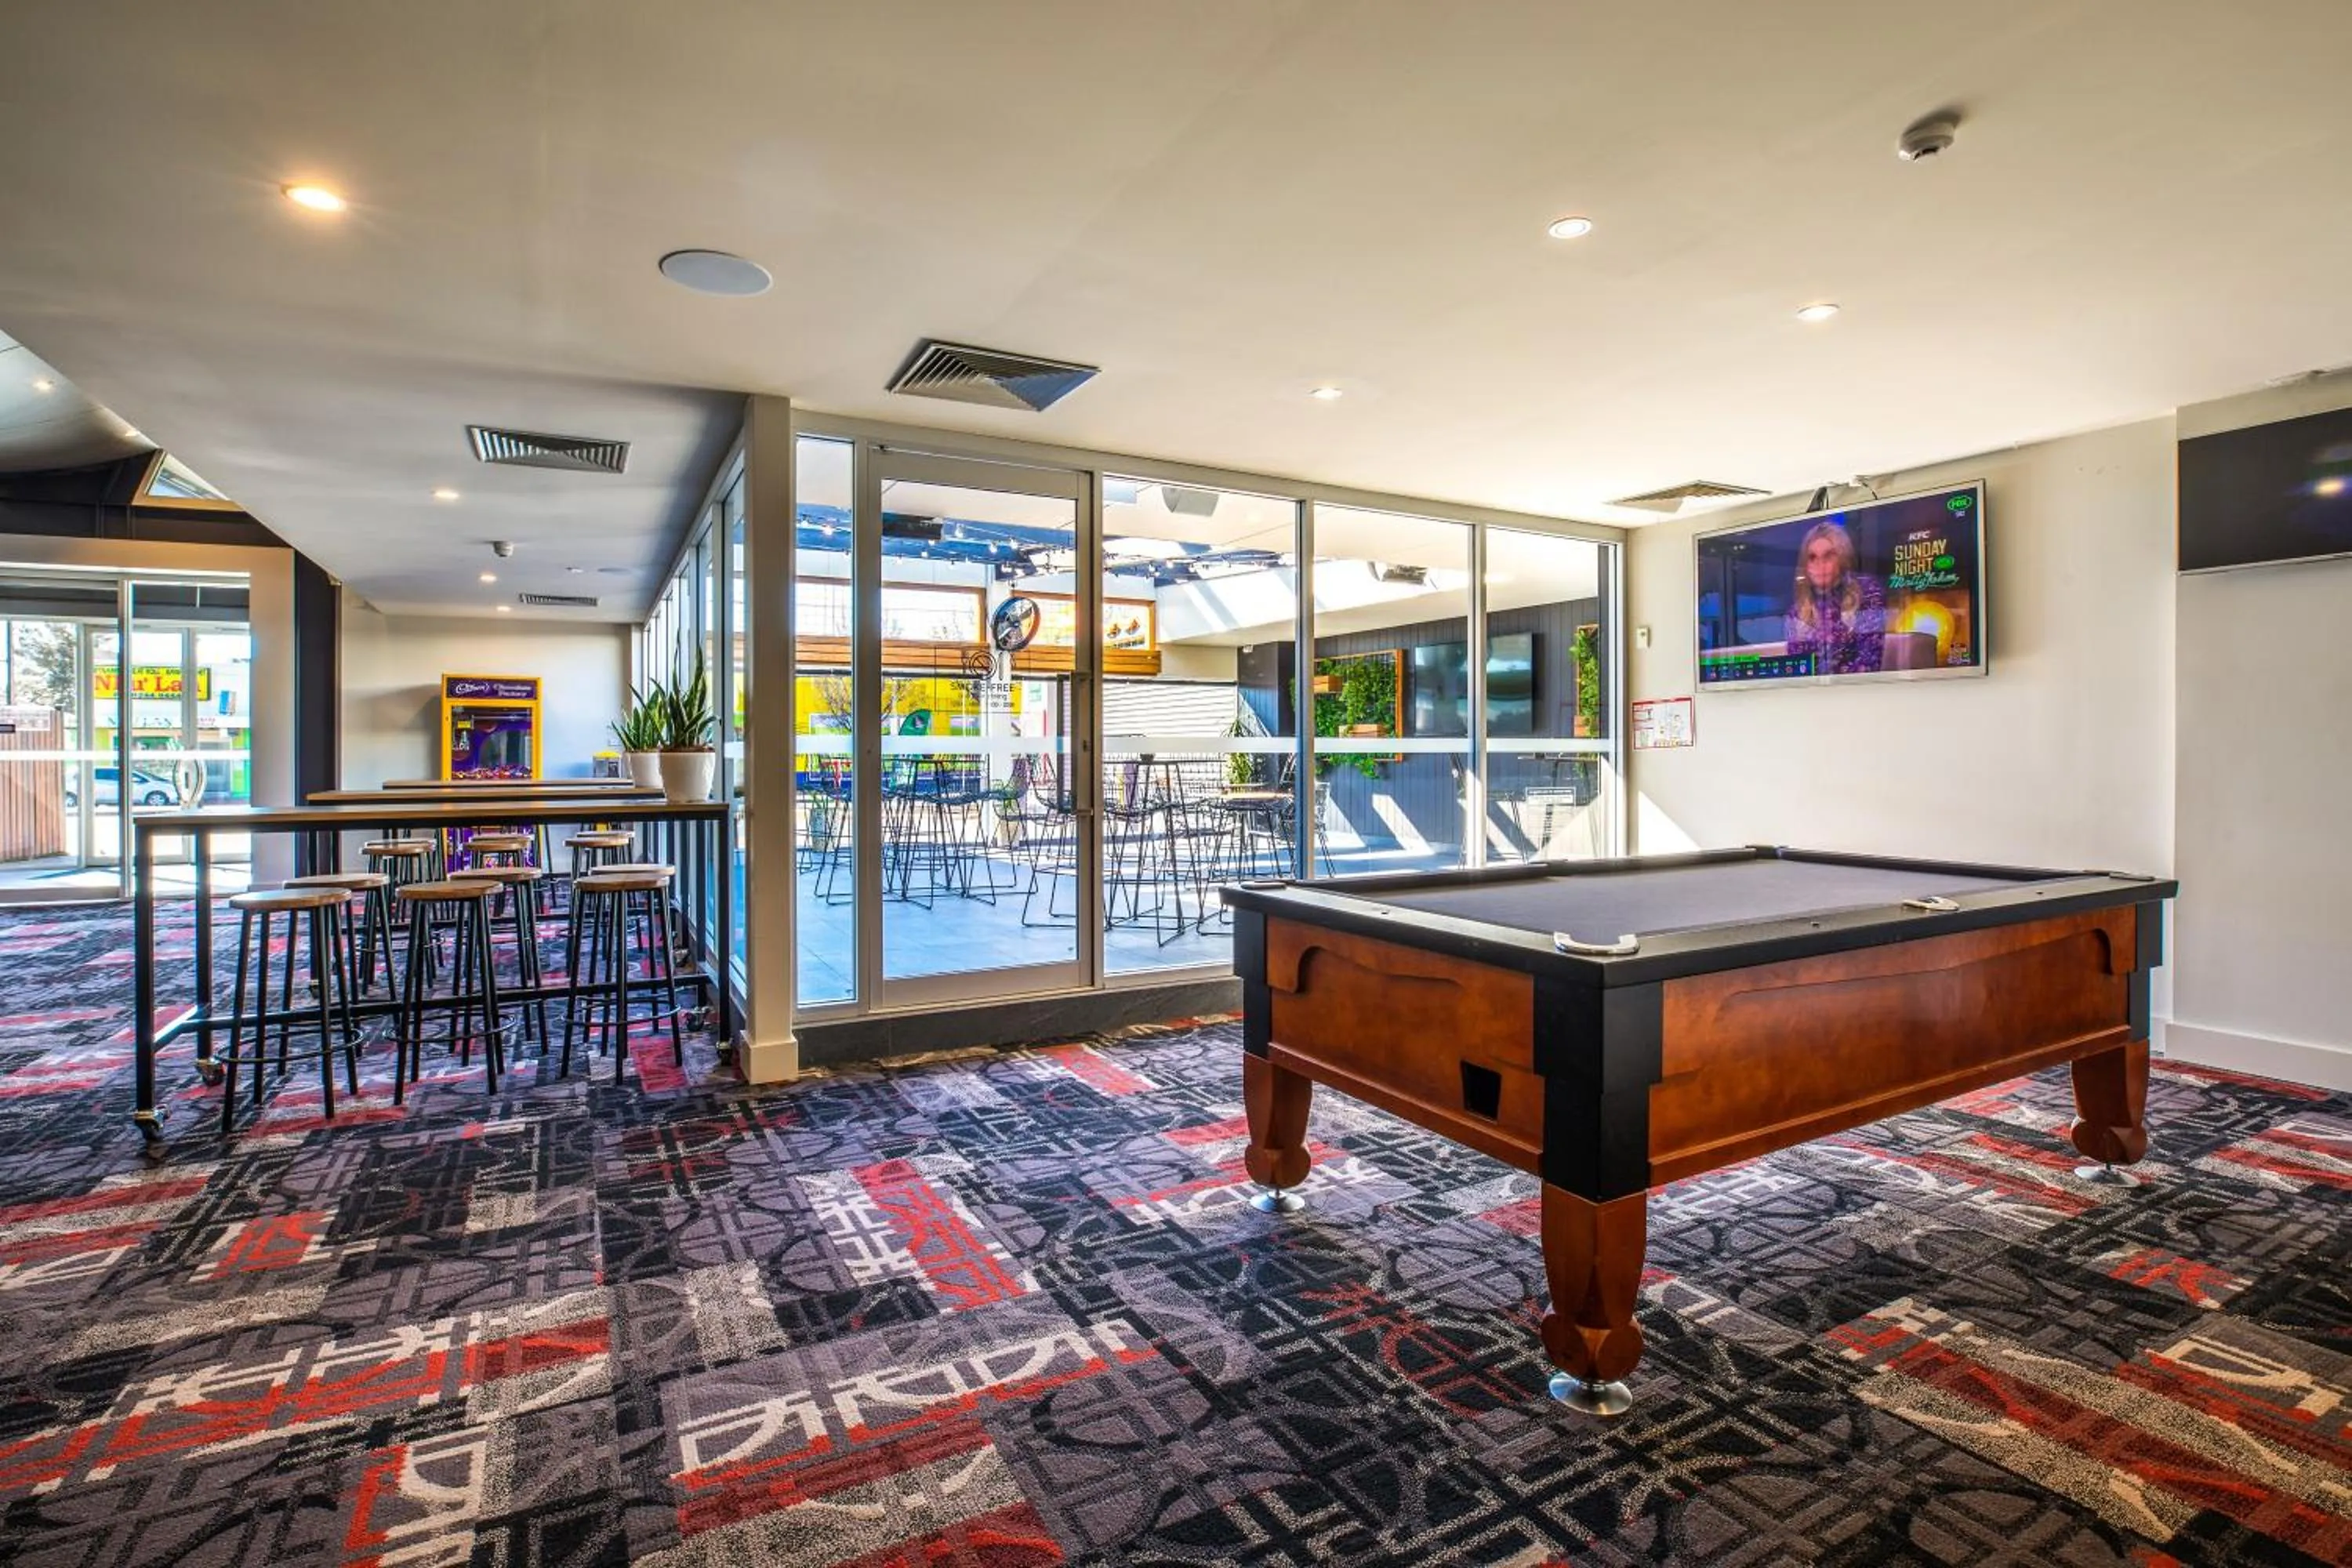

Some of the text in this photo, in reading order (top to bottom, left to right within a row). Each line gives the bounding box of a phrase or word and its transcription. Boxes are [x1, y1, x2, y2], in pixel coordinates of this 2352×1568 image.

[1908, 531, 1930, 540] KFC
[1894, 539, 1947, 561] SUNDAY
[1894, 557, 1934, 576] NIGHT
